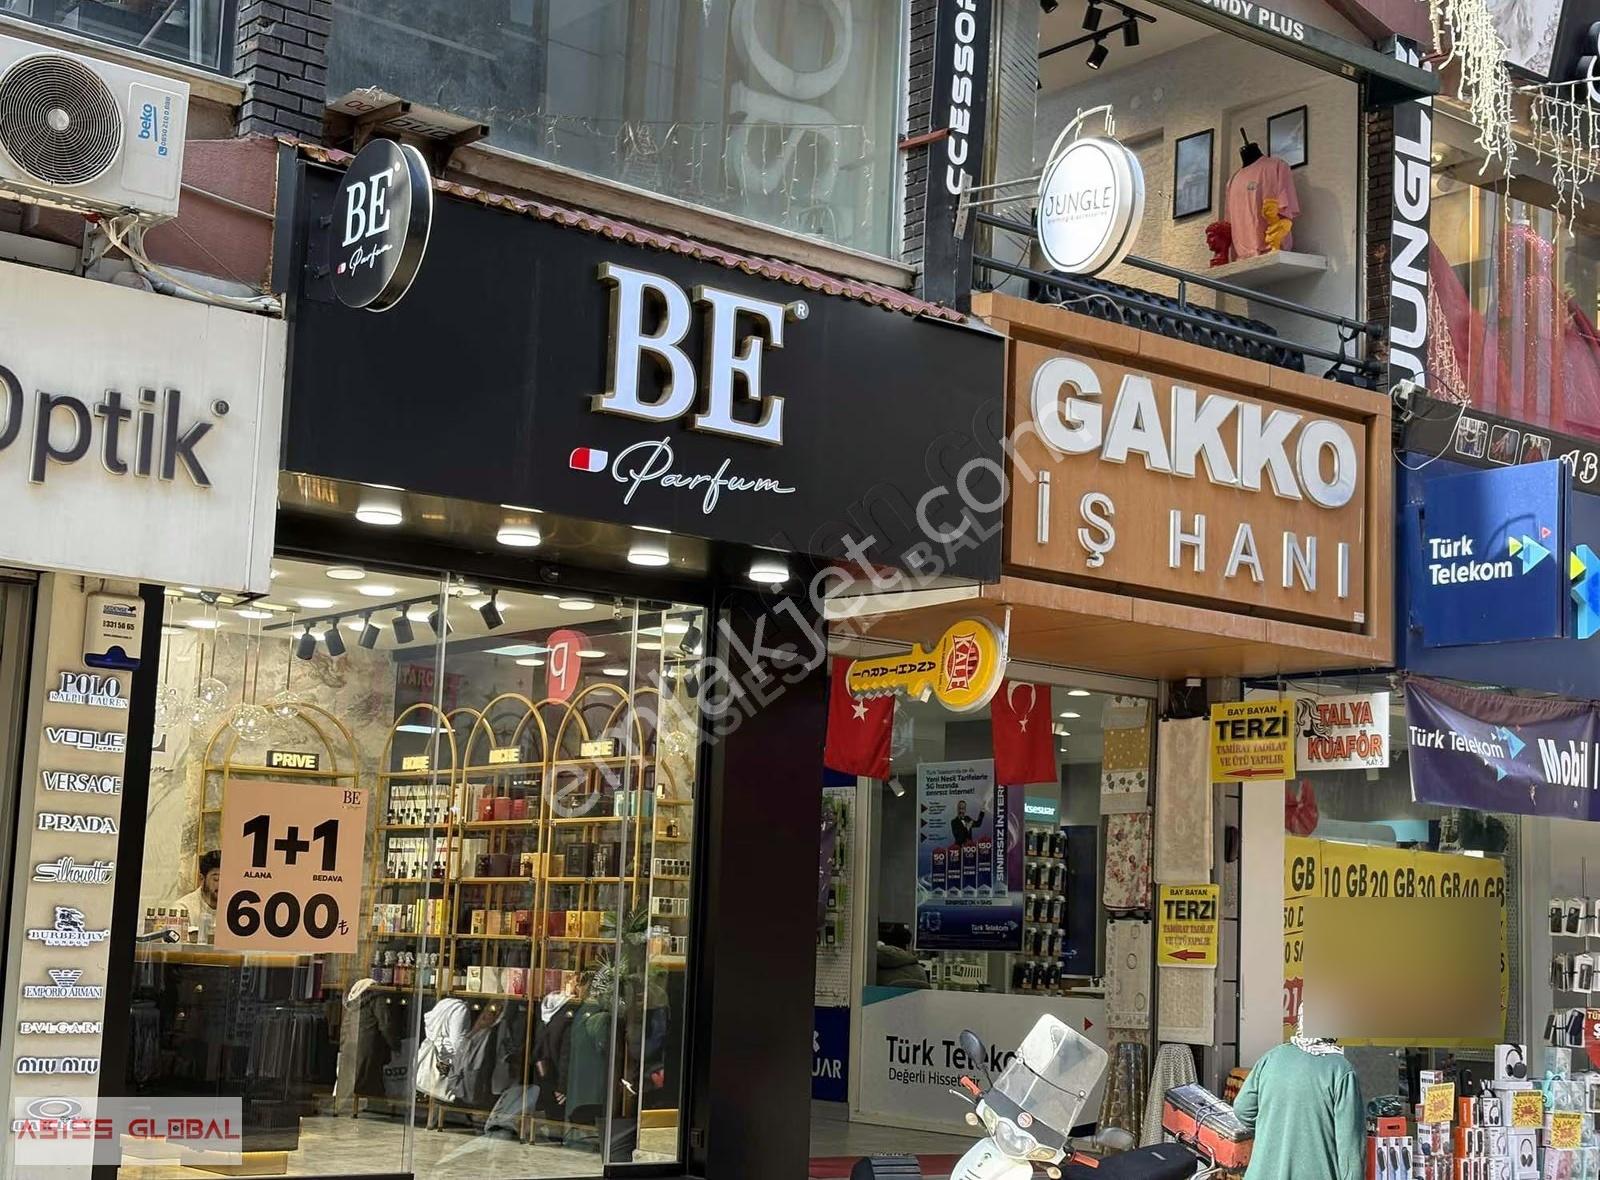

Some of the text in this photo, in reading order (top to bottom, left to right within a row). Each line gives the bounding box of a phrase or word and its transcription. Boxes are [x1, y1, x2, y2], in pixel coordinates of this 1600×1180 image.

[1203, 0, 1304, 41] NDY PLUS
[138, 103, 153, 139] beko
[342, 168, 394, 247] BE
[1045, 186, 1112, 217] JUNGLE
[592, 261, 784, 446] BE
[1031, 356, 1357, 509] GAKKO
[612, 436, 796, 514] Parfum
[1036, 470, 1350, 599] İŞ HANI
[1429, 535, 1473, 559] Türk
[1429, 561, 1513, 585] Telekom
[852, 661, 936, 678] ANAHTARCI
[948, 635, 974, 690] KALE
[61, 672, 121, 698] POLO
[51, 692, 128, 708] RALPH LAUREN
[1228, 706, 1277, 716] BAY BAYAN
[1215, 710, 1288, 741] TERZİ
[1317, 700, 1373, 727] TALYA
[272, 752, 316, 768] PRIVE
[1307, 731, 1383, 763] KUAFÖR
[1409, 725, 1445, 749] Türk
[1449, 730, 1505, 759] Telekom
[1537, 738, 1589, 788] Mobil
[1220, 757, 1231, 766] VE
[43, 771, 122, 795] VERSACE
[342, 790, 361, 805] BE
[39, 813, 117, 834] PRADA
[242, 814, 339, 871] 1+1
[949, 849, 960, 857] 75
[33, 857, 114, 884] Silhouette
[244, 871, 343, 883] ALANA BEDAVA
[1291, 856, 1315, 891] GB
[1324, 864, 1367, 897] 10 GB
[1370, 868, 1415, 897] 20 GB
[1418, 873, 1460, 897] 30 GB
[1163, 895, 1216, 920] TERZİ
[30, 930, 104, 940] BURBERRY
[26, 987, 67, 997] EMPORIO
[22, 1023, 101, 1033] BVLGARI
[886, 1035, 935, 1066] Türk
[888, 1067, 925, 1085] Değerli
